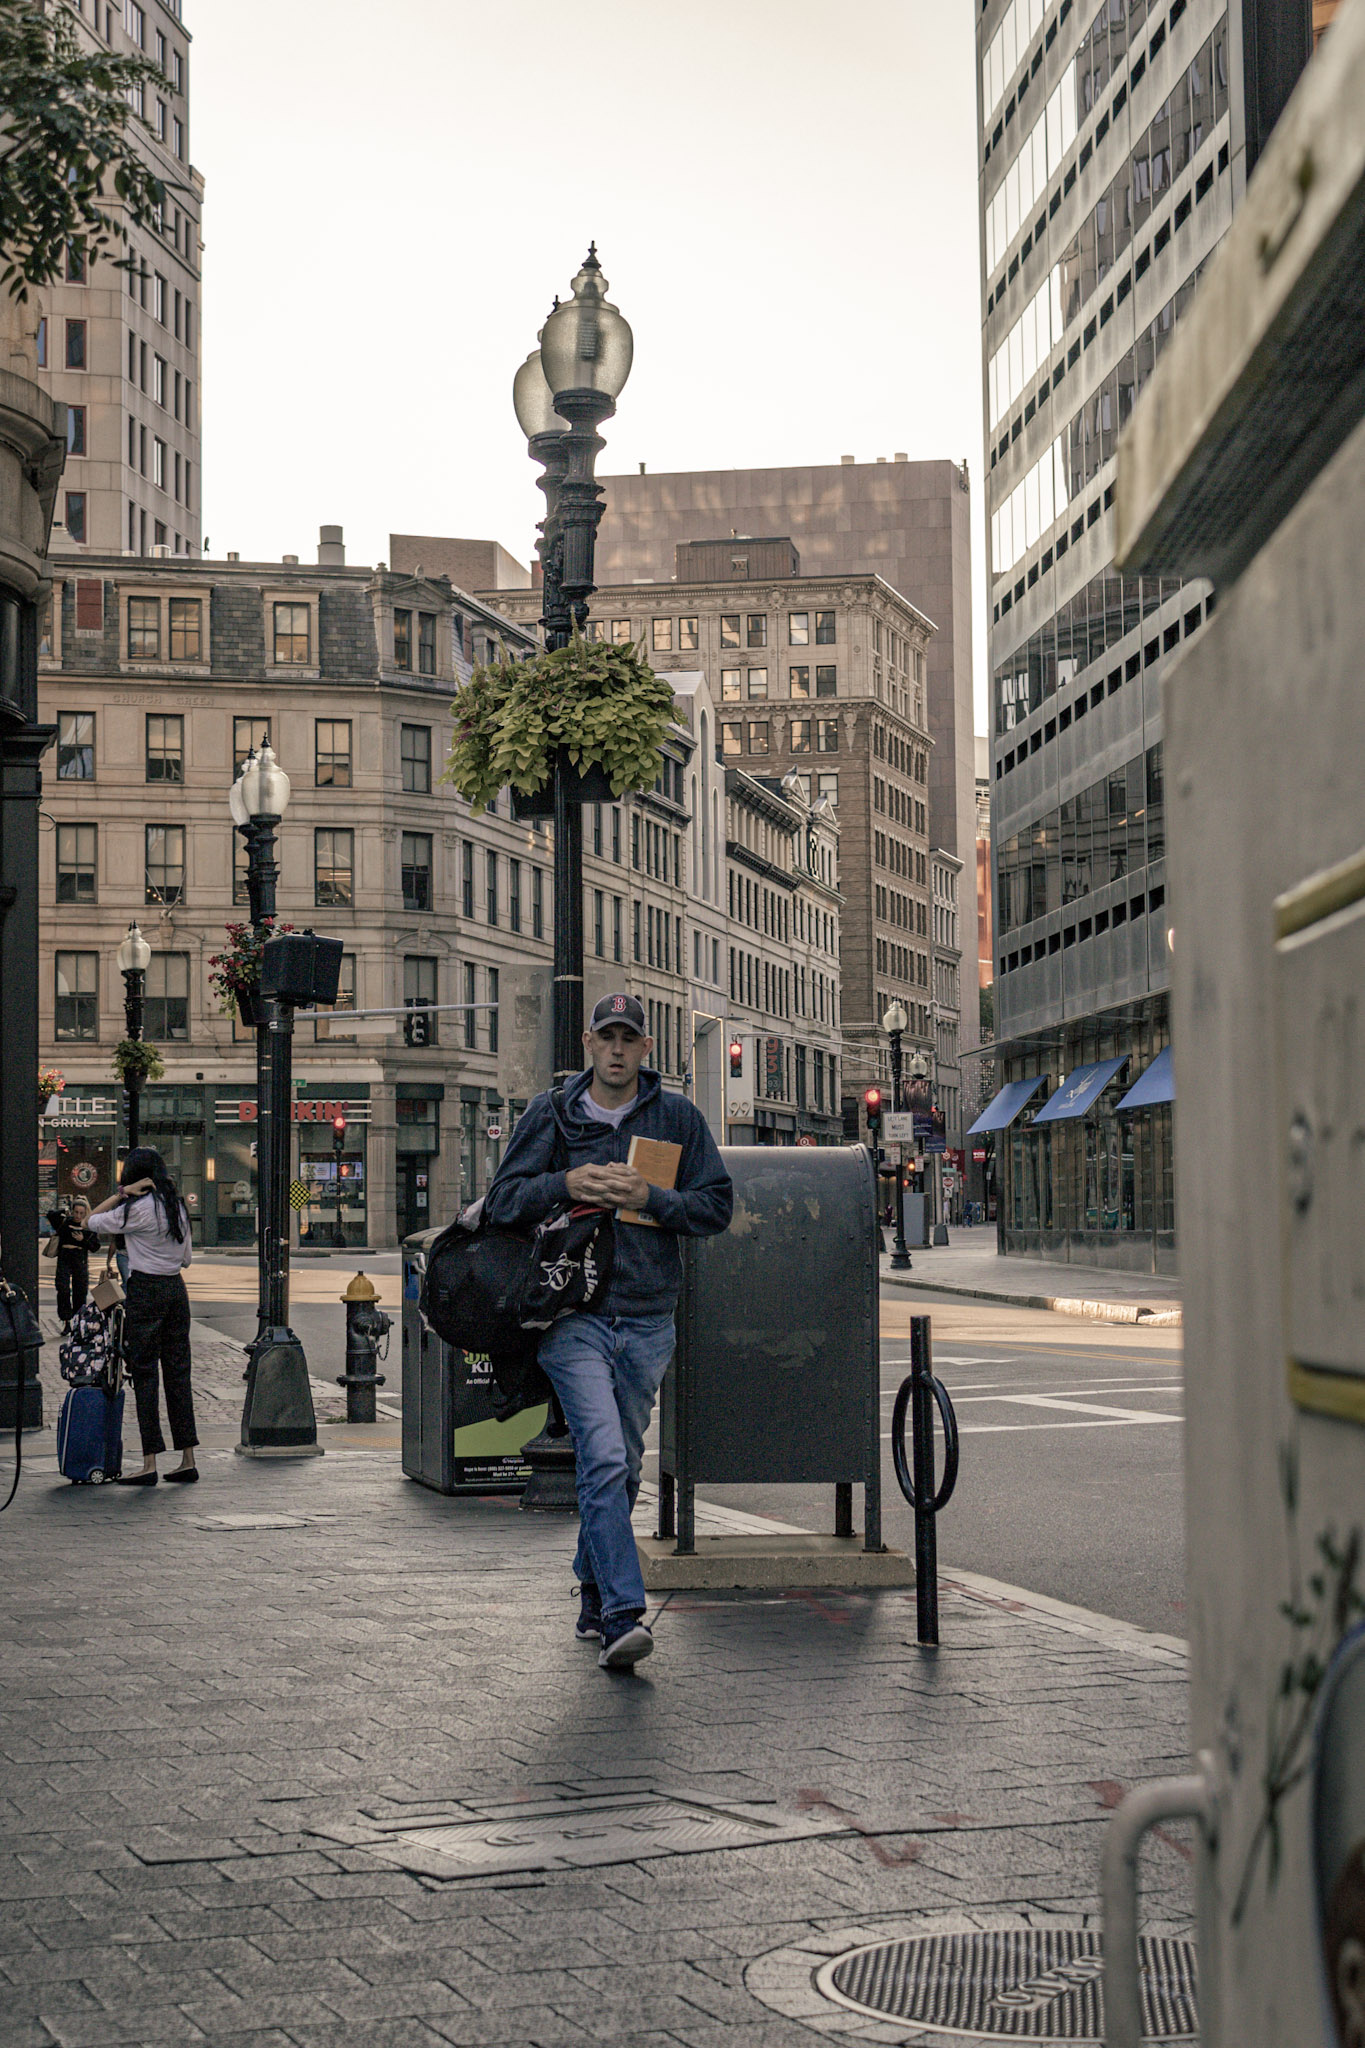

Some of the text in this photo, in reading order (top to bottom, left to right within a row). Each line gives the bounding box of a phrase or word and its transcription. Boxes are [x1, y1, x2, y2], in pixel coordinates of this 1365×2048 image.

[113, 694, 215, 706] CHURCH GREEN
[611, 996, 627, 1012] B
[768, 1080, 779, 1088] 93
[58, 1097, 106, 1115] TLE
[239, 1101, 349, 1122] DKIN'
[729, 1100, 751, 1116] 99
[50, 1118, 91, 1128] GRILL
